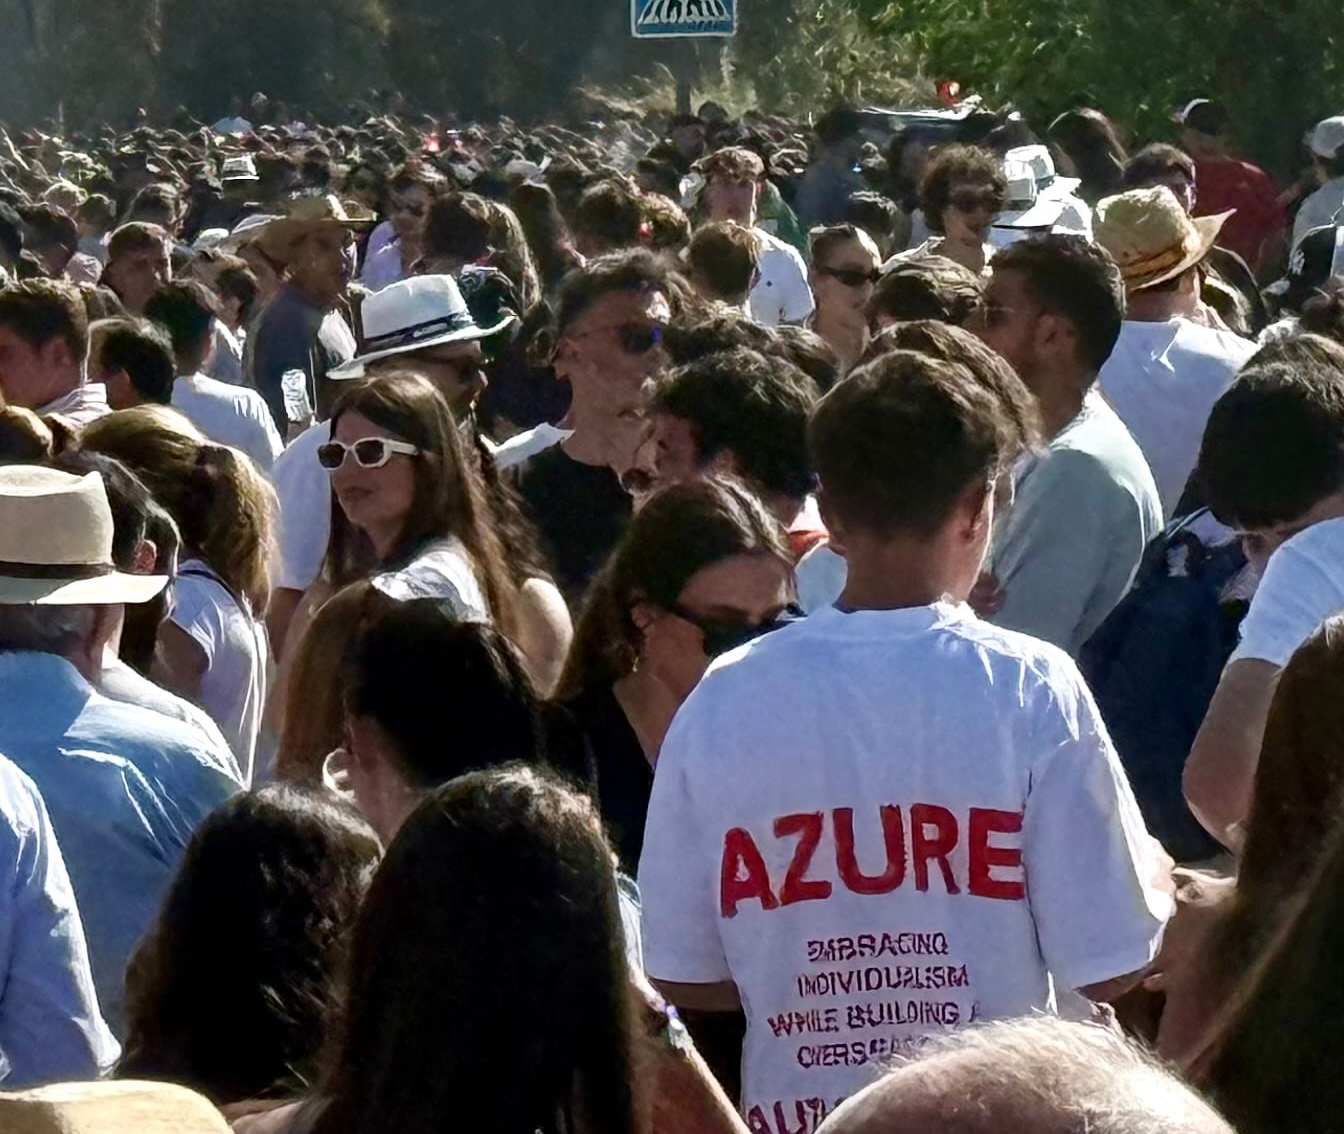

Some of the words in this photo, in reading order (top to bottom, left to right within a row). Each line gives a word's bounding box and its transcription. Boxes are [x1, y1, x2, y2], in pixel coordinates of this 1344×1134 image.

[720, 803, 1025, 918] AZURE
[807, 932, 949, 962] EMBRACING
[797, 964, 969, 998] INDIVIDUALISM
[767, 1008, 839, 1037] WHILE
[846, 1000, 960, 1029] BUILDING
